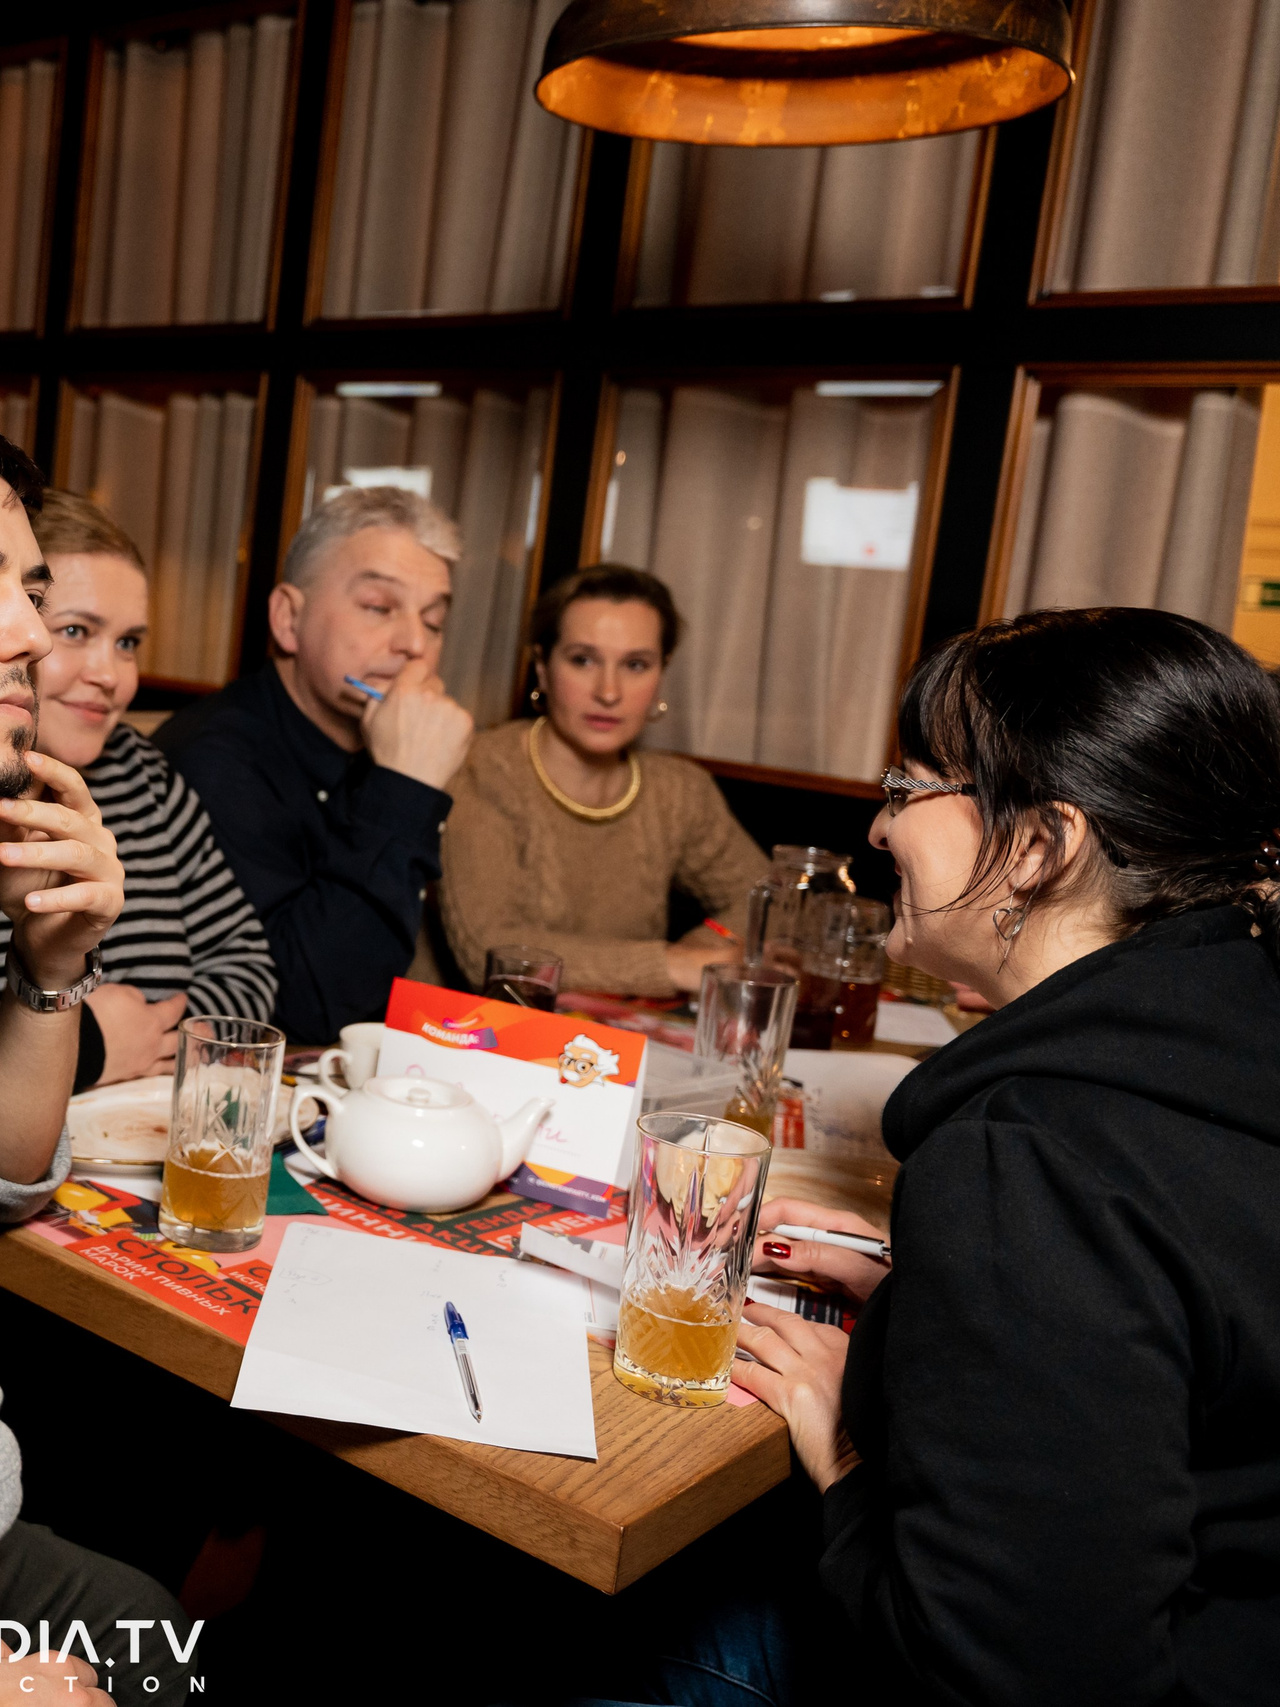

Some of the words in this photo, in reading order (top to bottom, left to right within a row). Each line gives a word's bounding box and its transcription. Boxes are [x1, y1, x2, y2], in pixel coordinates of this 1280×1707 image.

[79, 1248, 143, 1281] МАРОК
[89, 1244, 156, 1277] ДАРИМ
[152, 1274, 232, 1316] ПИВНЫХ
